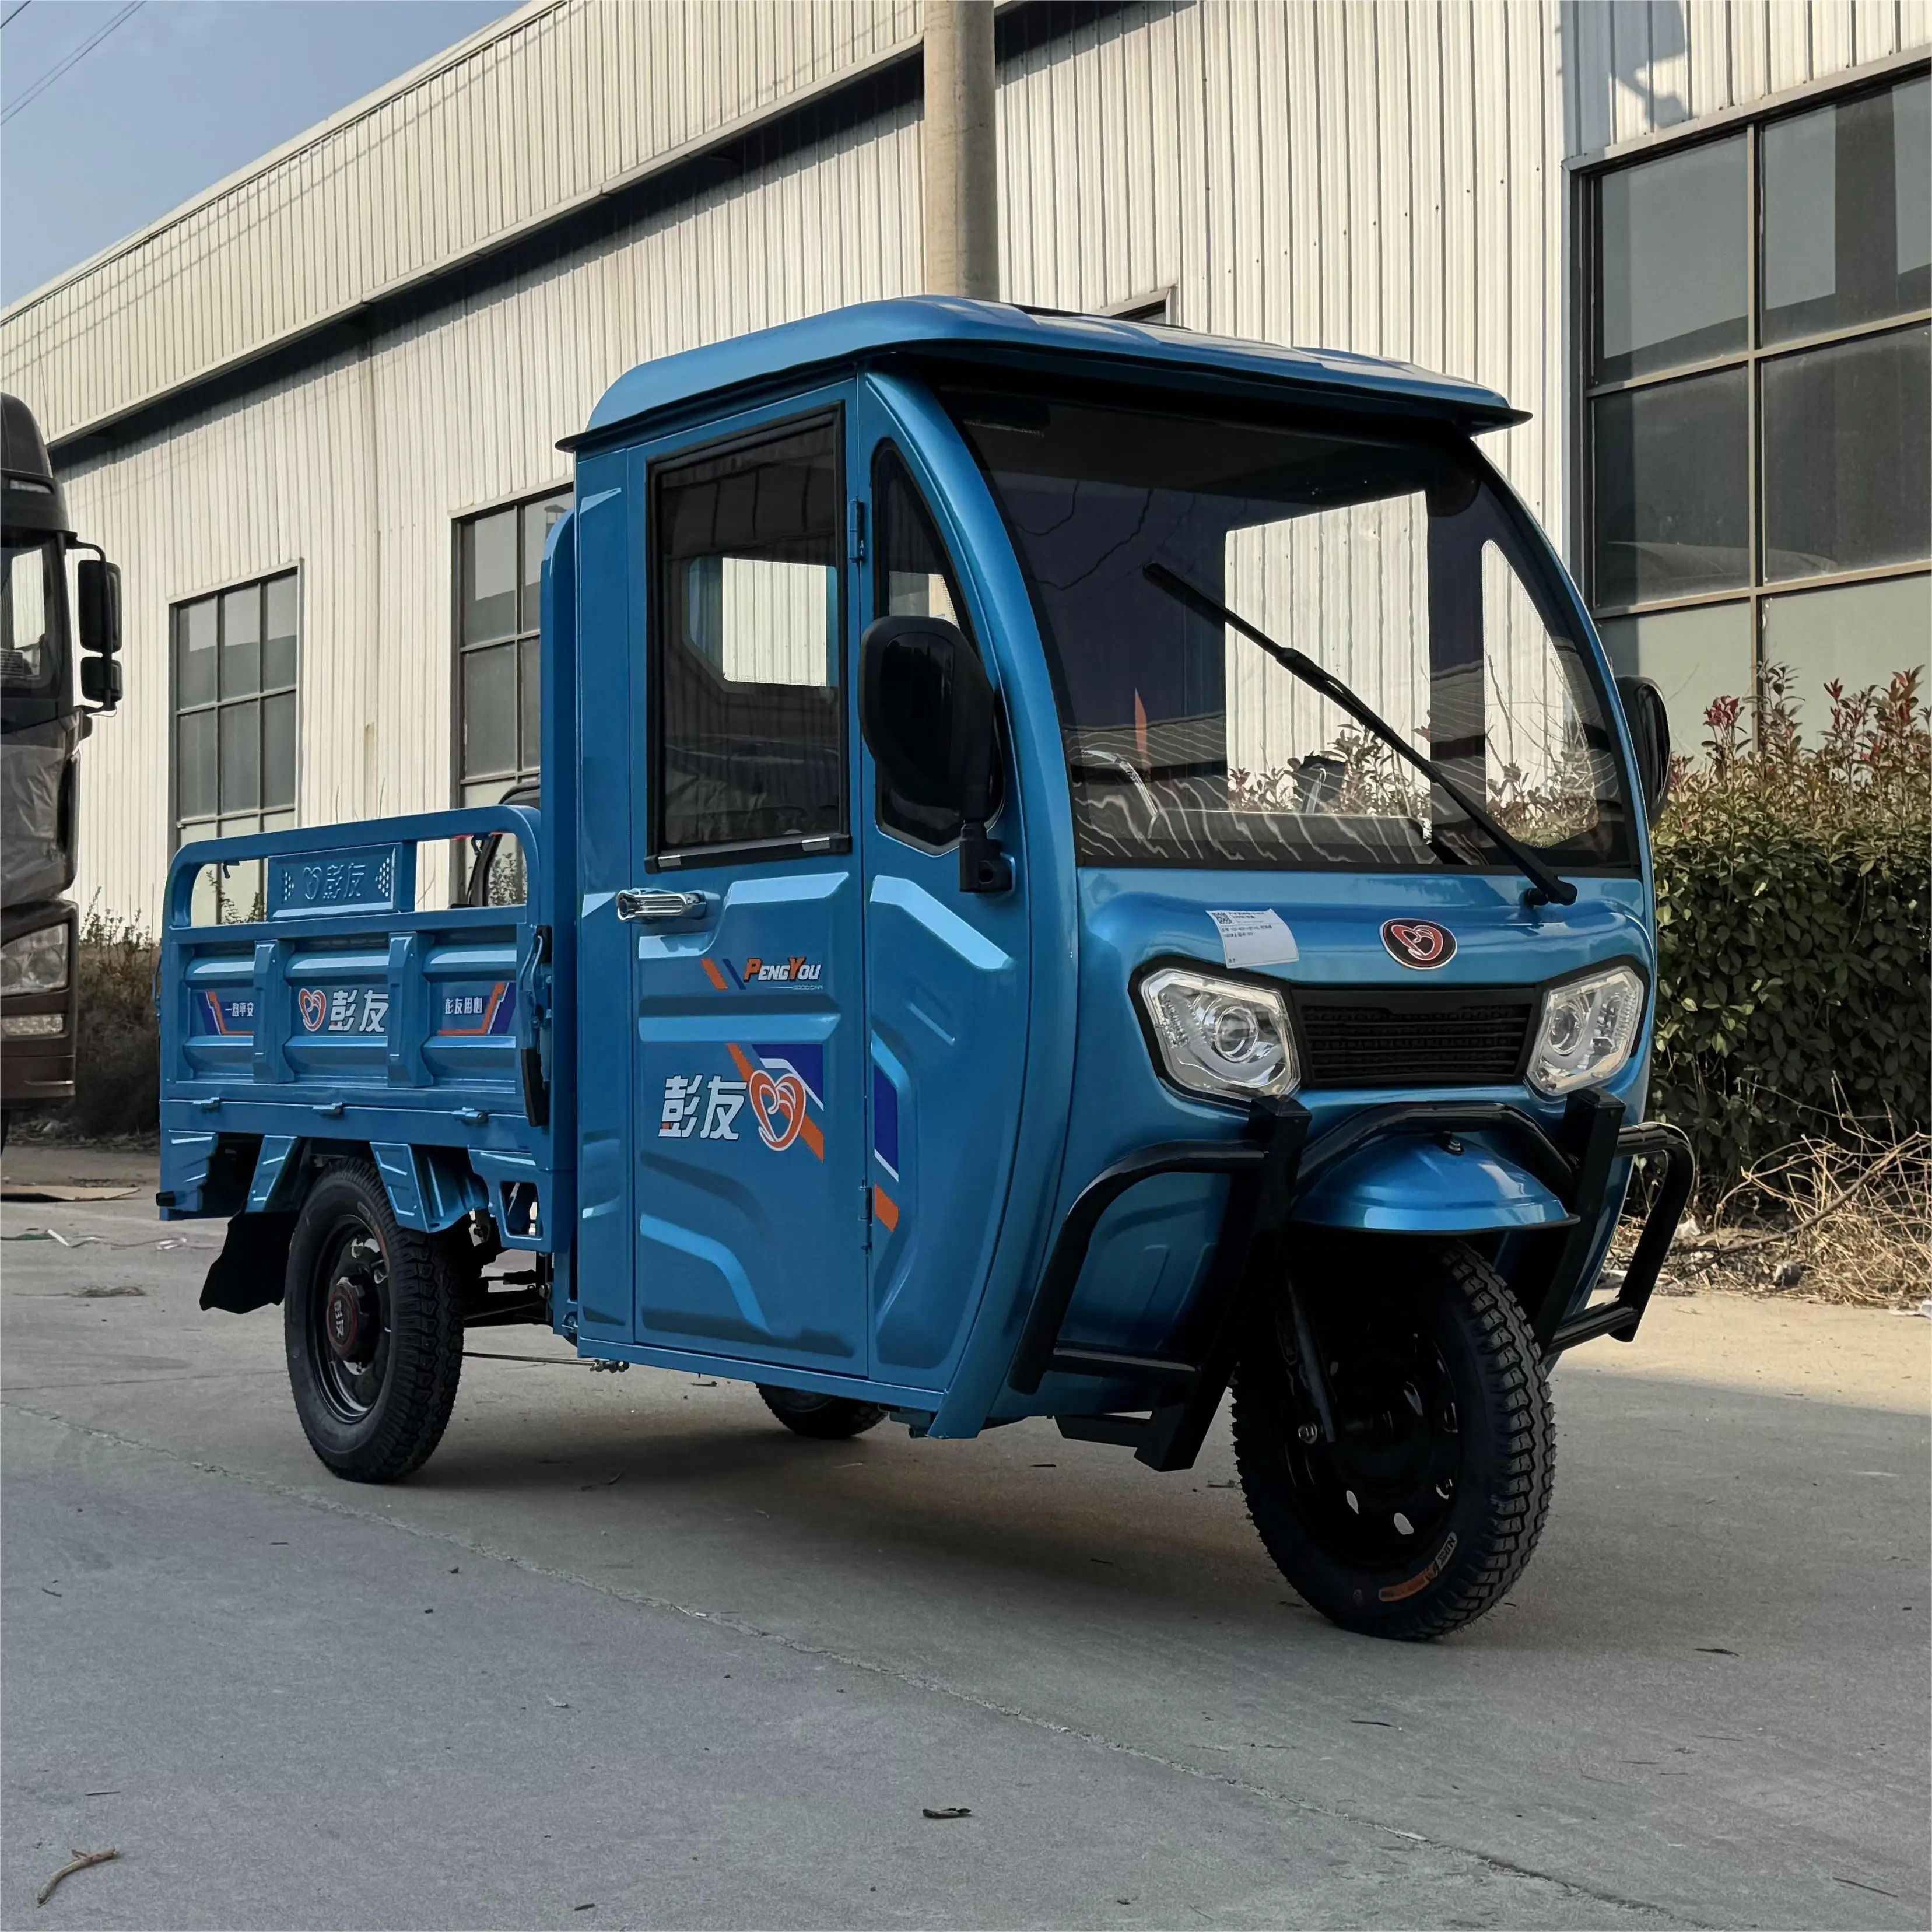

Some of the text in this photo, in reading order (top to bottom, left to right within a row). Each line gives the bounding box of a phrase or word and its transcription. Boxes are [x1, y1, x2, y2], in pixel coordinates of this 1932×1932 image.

[322, 864, 366, 899] 彭友
[225, 1002, 254, 1017] 一路平安
[328, 990, 390, 1032] 彭友
[658, 1074, 748, 1140] 彭友
